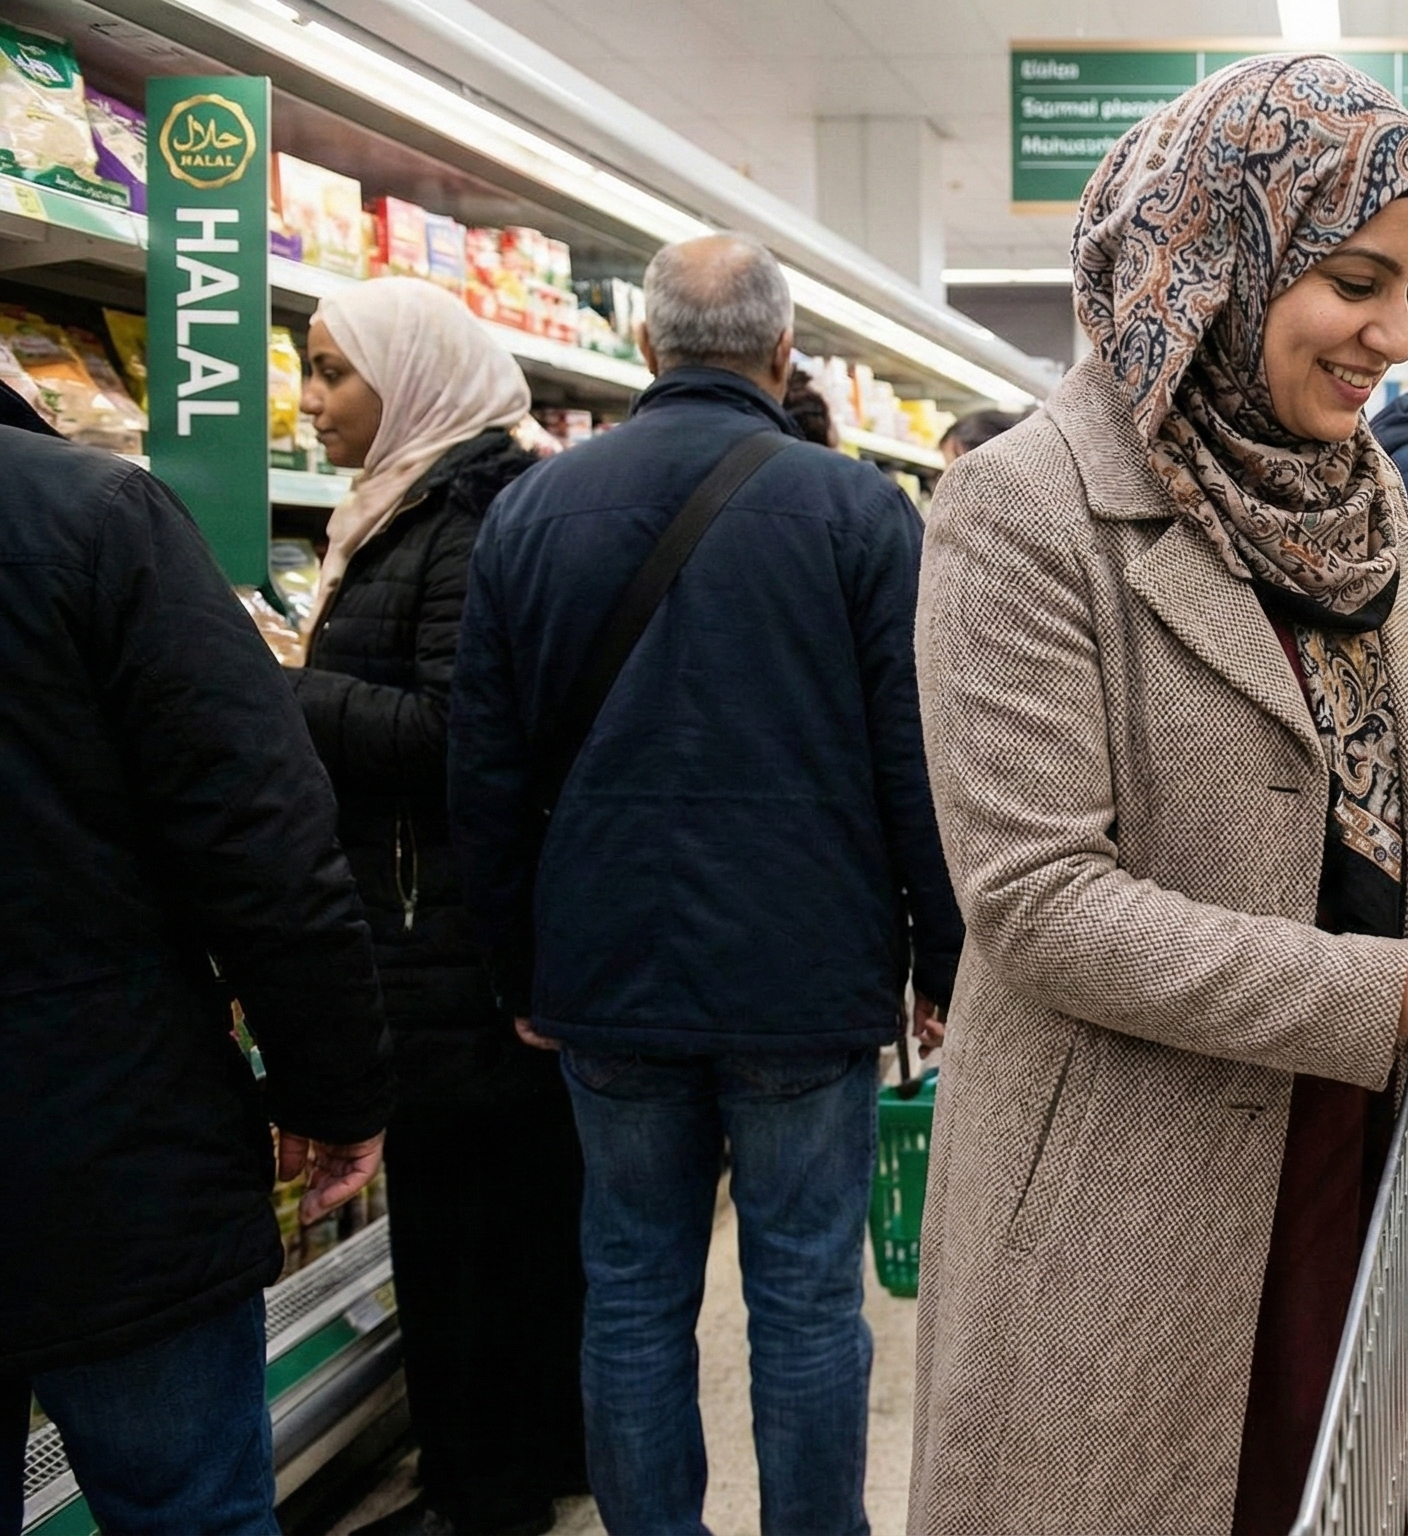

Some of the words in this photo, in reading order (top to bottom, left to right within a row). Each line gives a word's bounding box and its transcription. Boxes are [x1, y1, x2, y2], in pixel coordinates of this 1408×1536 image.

[173, 114, 243, 151] حلال
[180, 155, 236, 167] HALAL
[176, 208, 240, 437] HALAL
